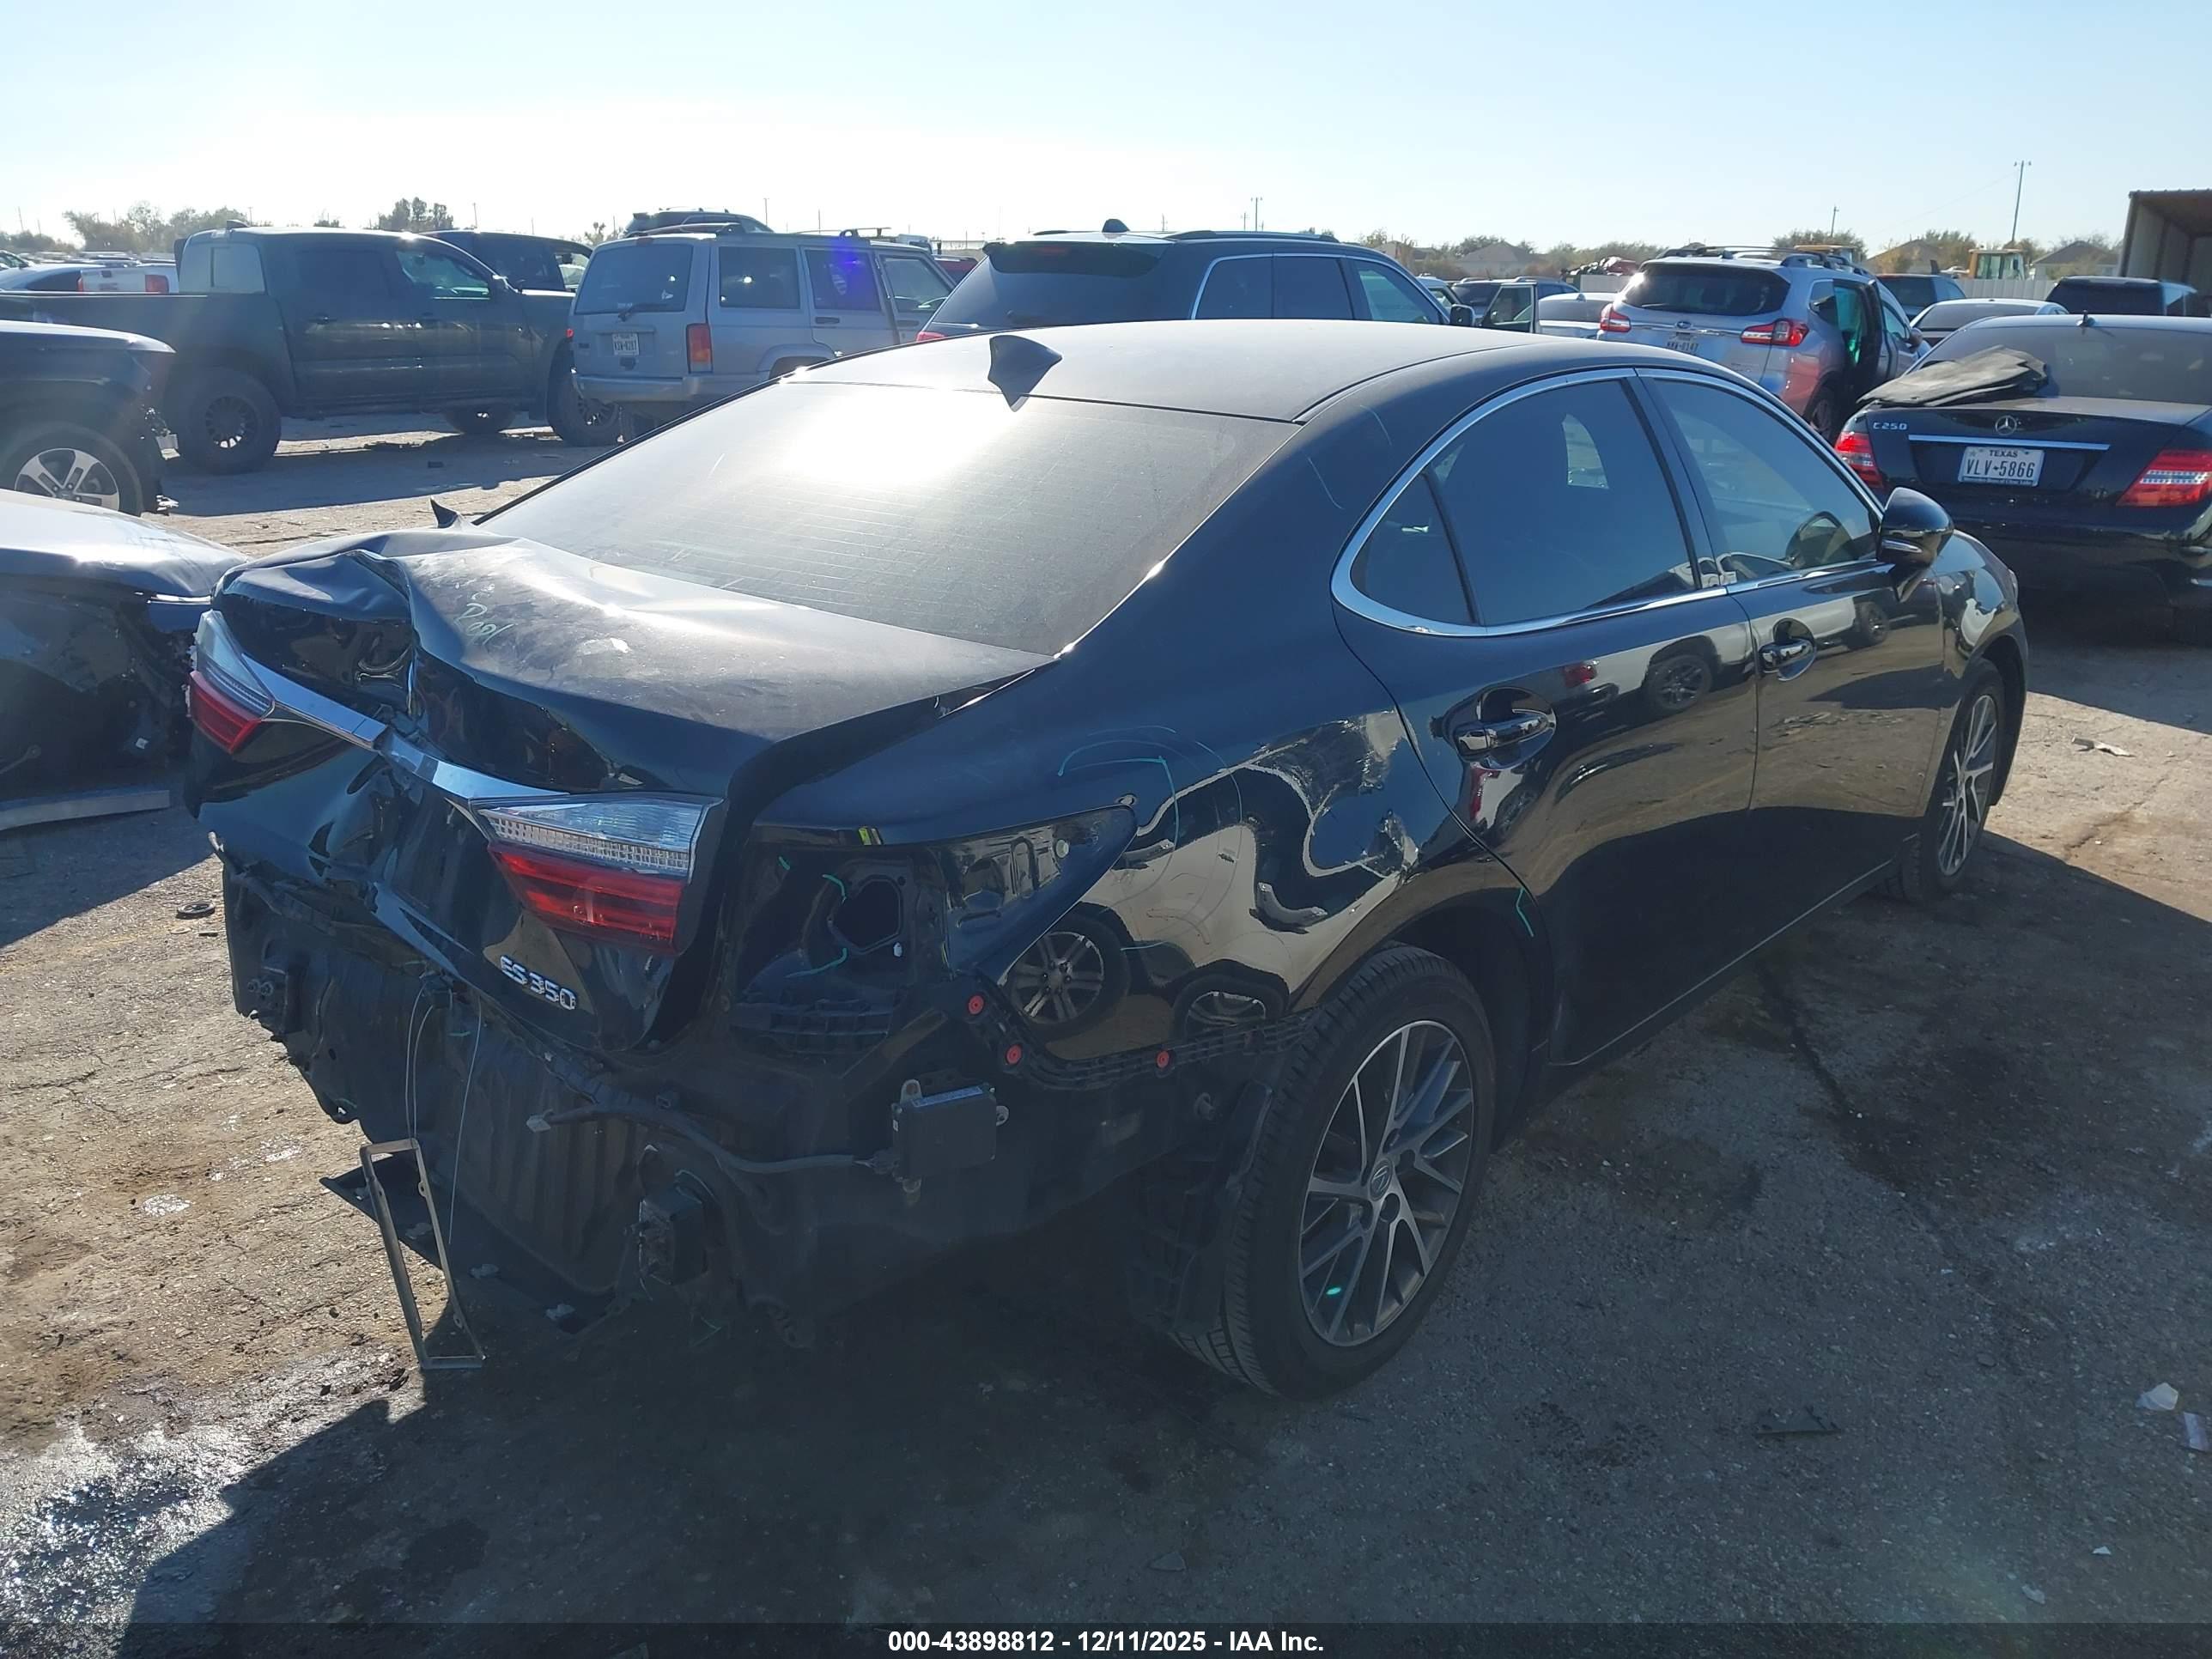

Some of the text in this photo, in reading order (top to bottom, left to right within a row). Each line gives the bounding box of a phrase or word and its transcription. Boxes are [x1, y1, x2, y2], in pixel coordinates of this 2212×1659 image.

[1989, 449, 2019, 458] TEXAS
[501, 956, 576, 1010] ES 350
